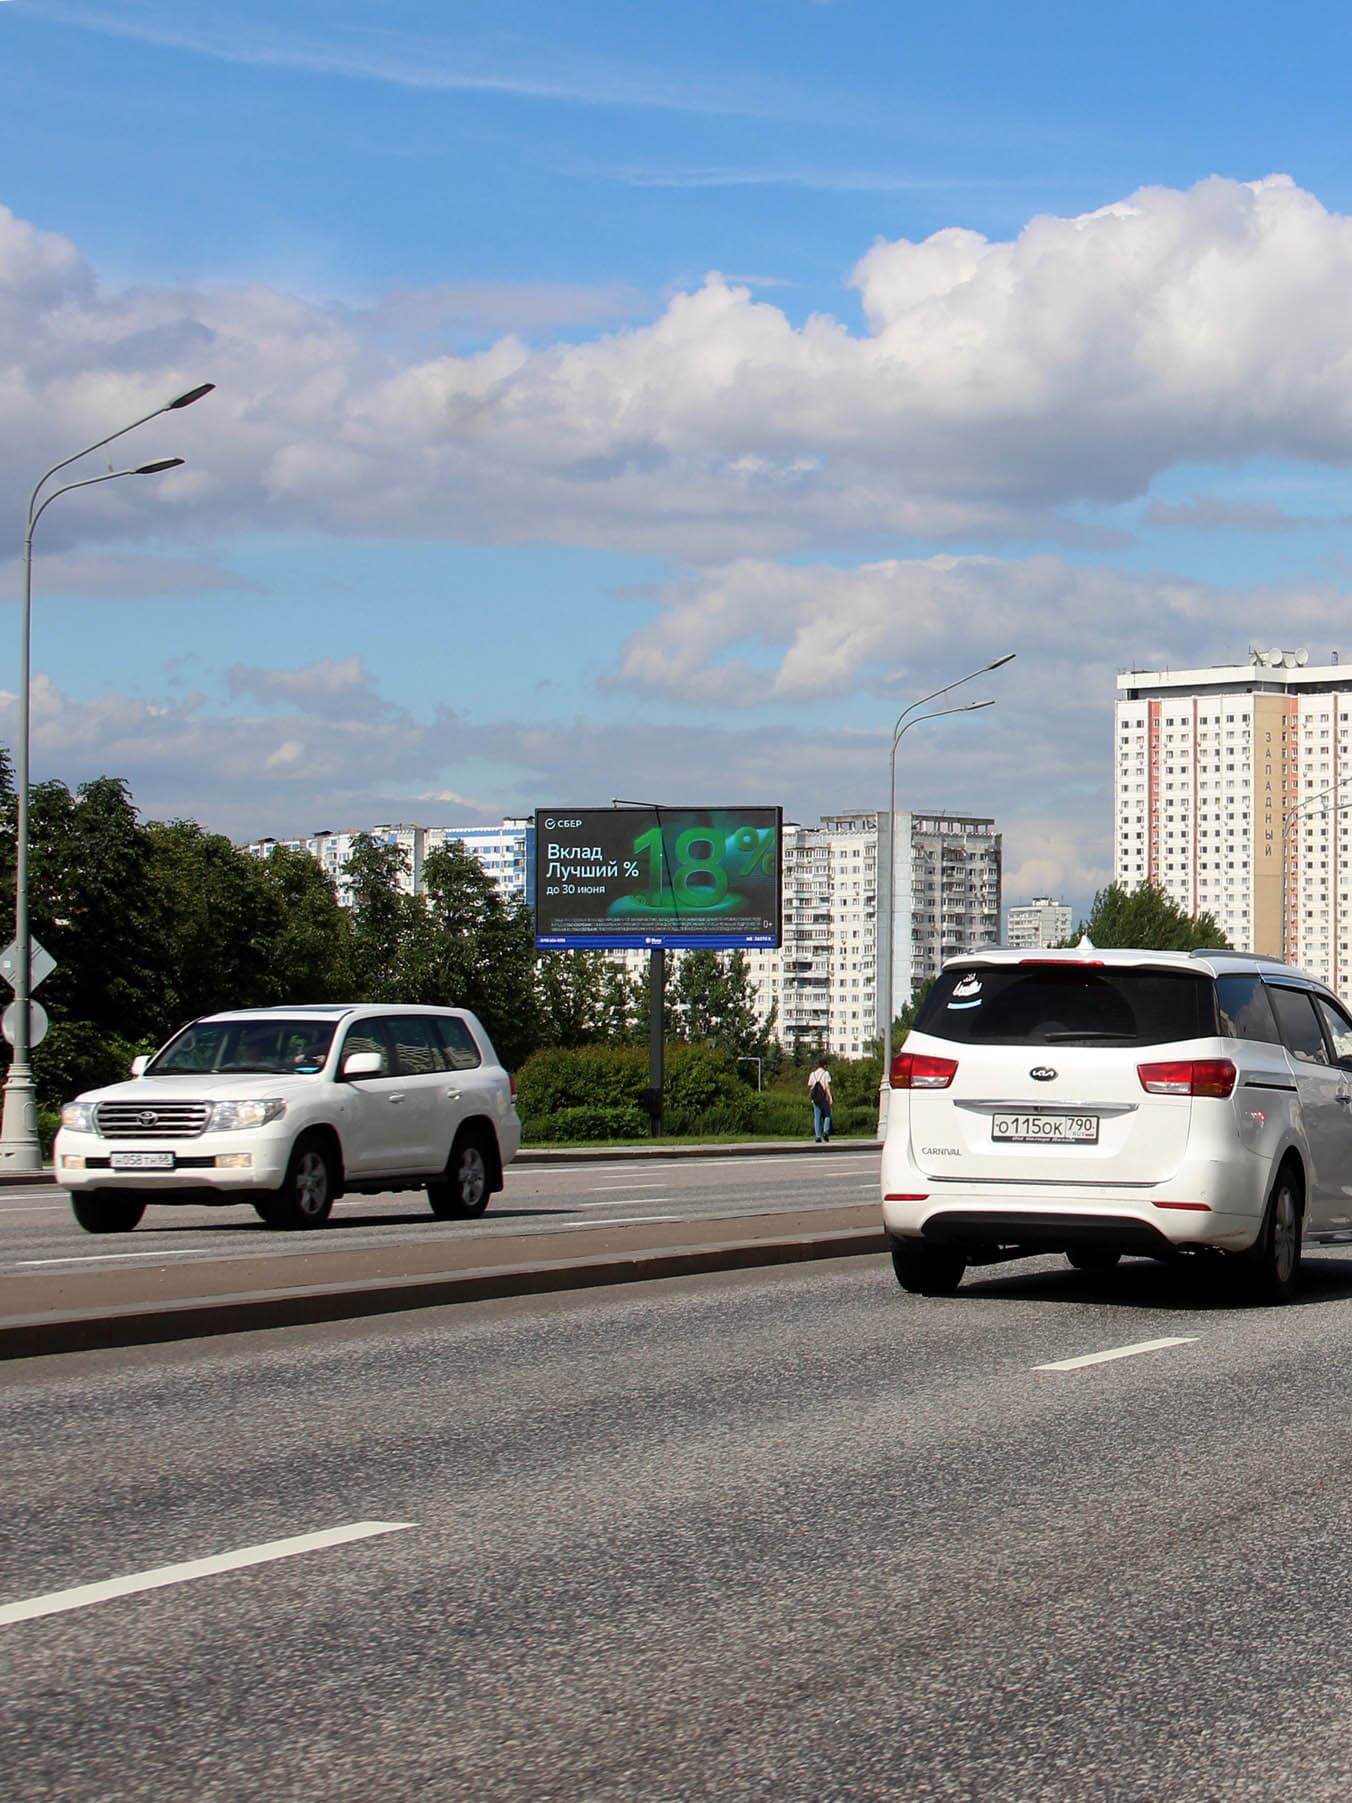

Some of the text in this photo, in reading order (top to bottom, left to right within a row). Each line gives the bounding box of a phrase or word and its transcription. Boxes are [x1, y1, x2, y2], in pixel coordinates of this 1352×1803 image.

[1264, 731, 1274, 857] ЗАПАДНЫЙ
[557, 820, 582, 828] СБЕР
[547, 844, 603, 861] Вклад
[546, 860, 640, 882] Лучший %
[546, 884, 606, 895] до 30 июня
[763, 919, 773, 929] 0+
[921, 1147, 962, 1157] CARNIVAL
